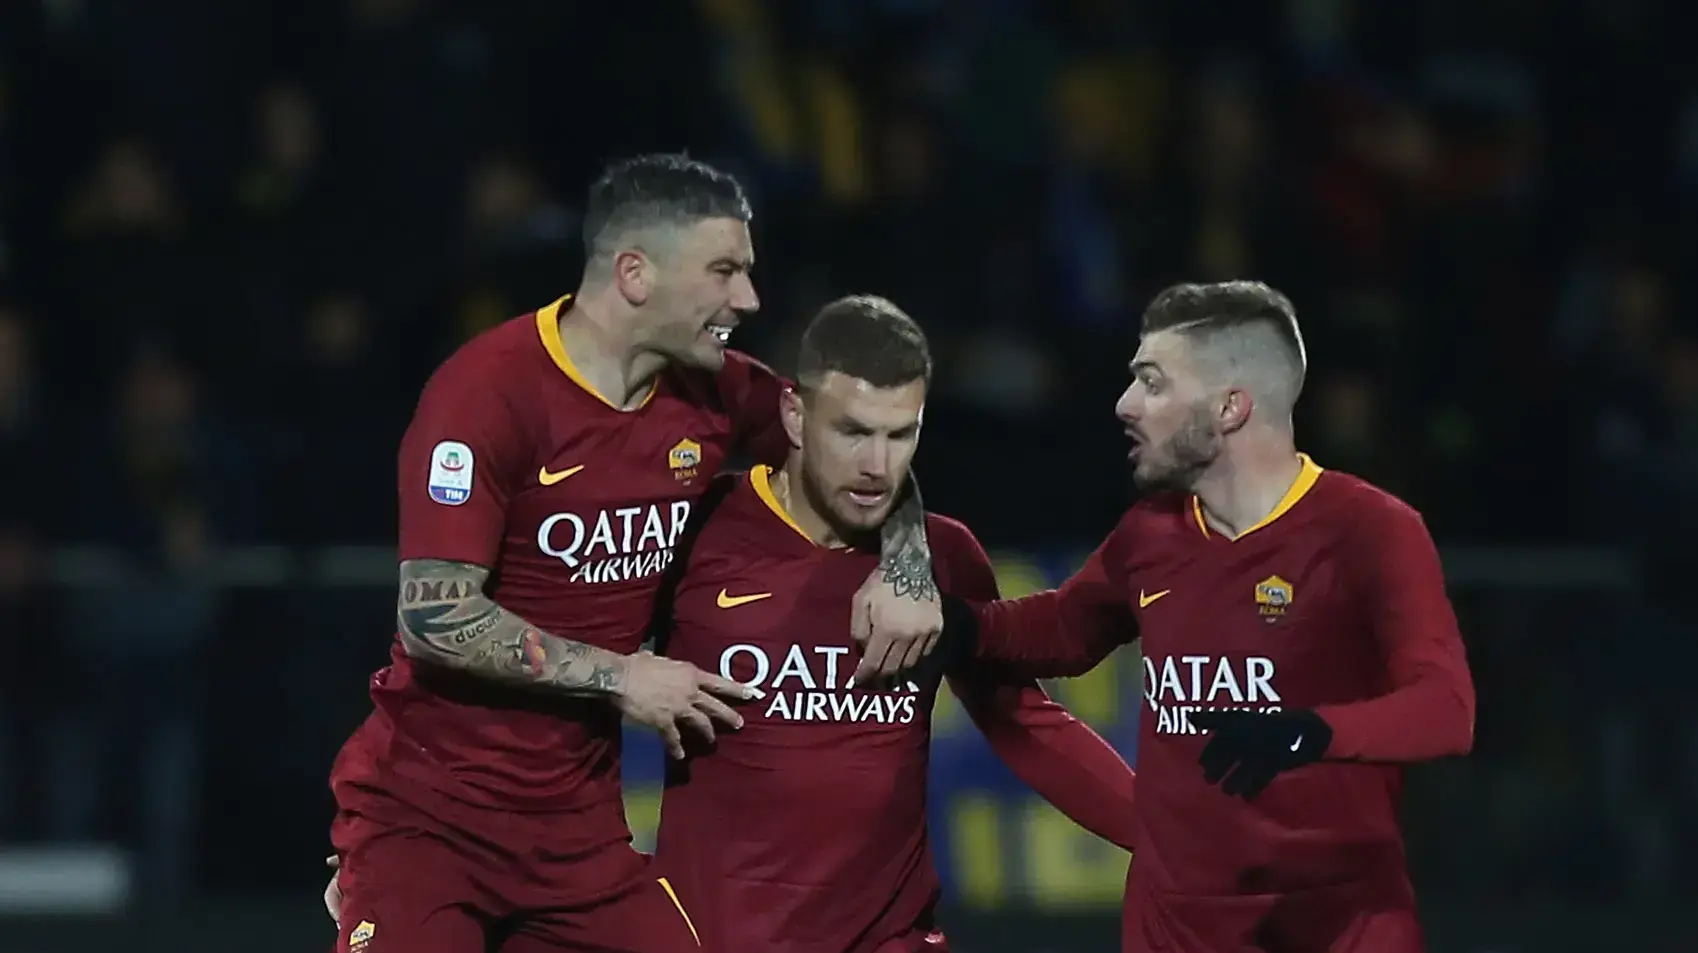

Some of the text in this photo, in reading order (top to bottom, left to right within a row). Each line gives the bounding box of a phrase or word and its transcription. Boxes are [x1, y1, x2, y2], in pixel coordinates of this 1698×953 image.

[537, 500, 690, 568] QATAR
[718, 643, 920, 700] QAT
[764, 691, 917, 725] AIRWAYS
